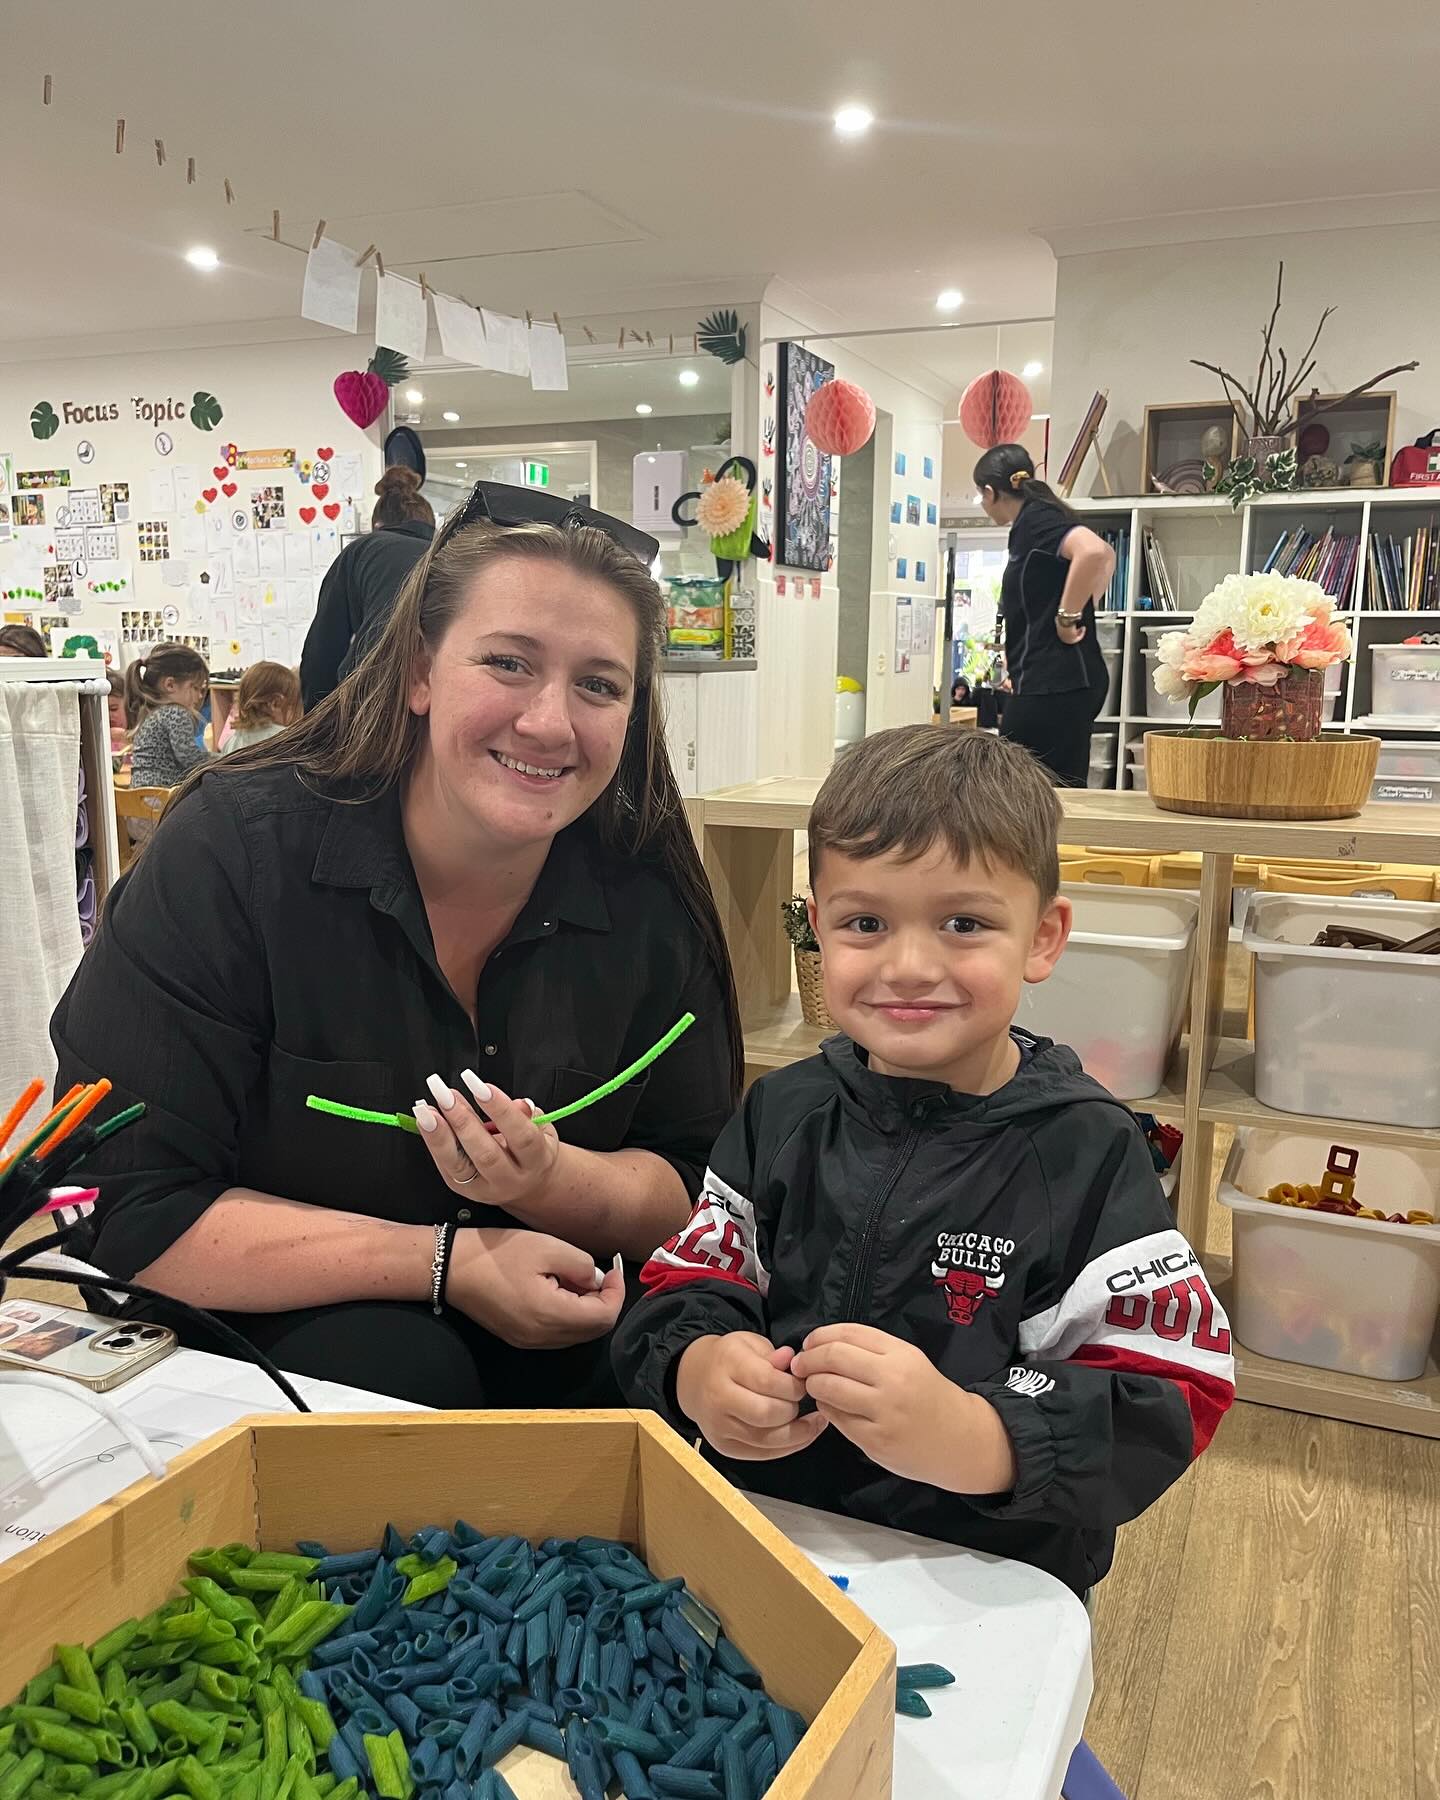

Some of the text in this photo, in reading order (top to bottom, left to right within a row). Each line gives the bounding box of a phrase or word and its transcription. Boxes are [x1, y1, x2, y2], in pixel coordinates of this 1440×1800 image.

[62, 396, 185, 427] Focus Topic
[1410, 472, 1433, 480] FIRST
[937, 1232, 1015, 1256] CHICAGO
[938, 1248, 1001, 1272] BULLS
[5, 1524, 46, 1541] tion
